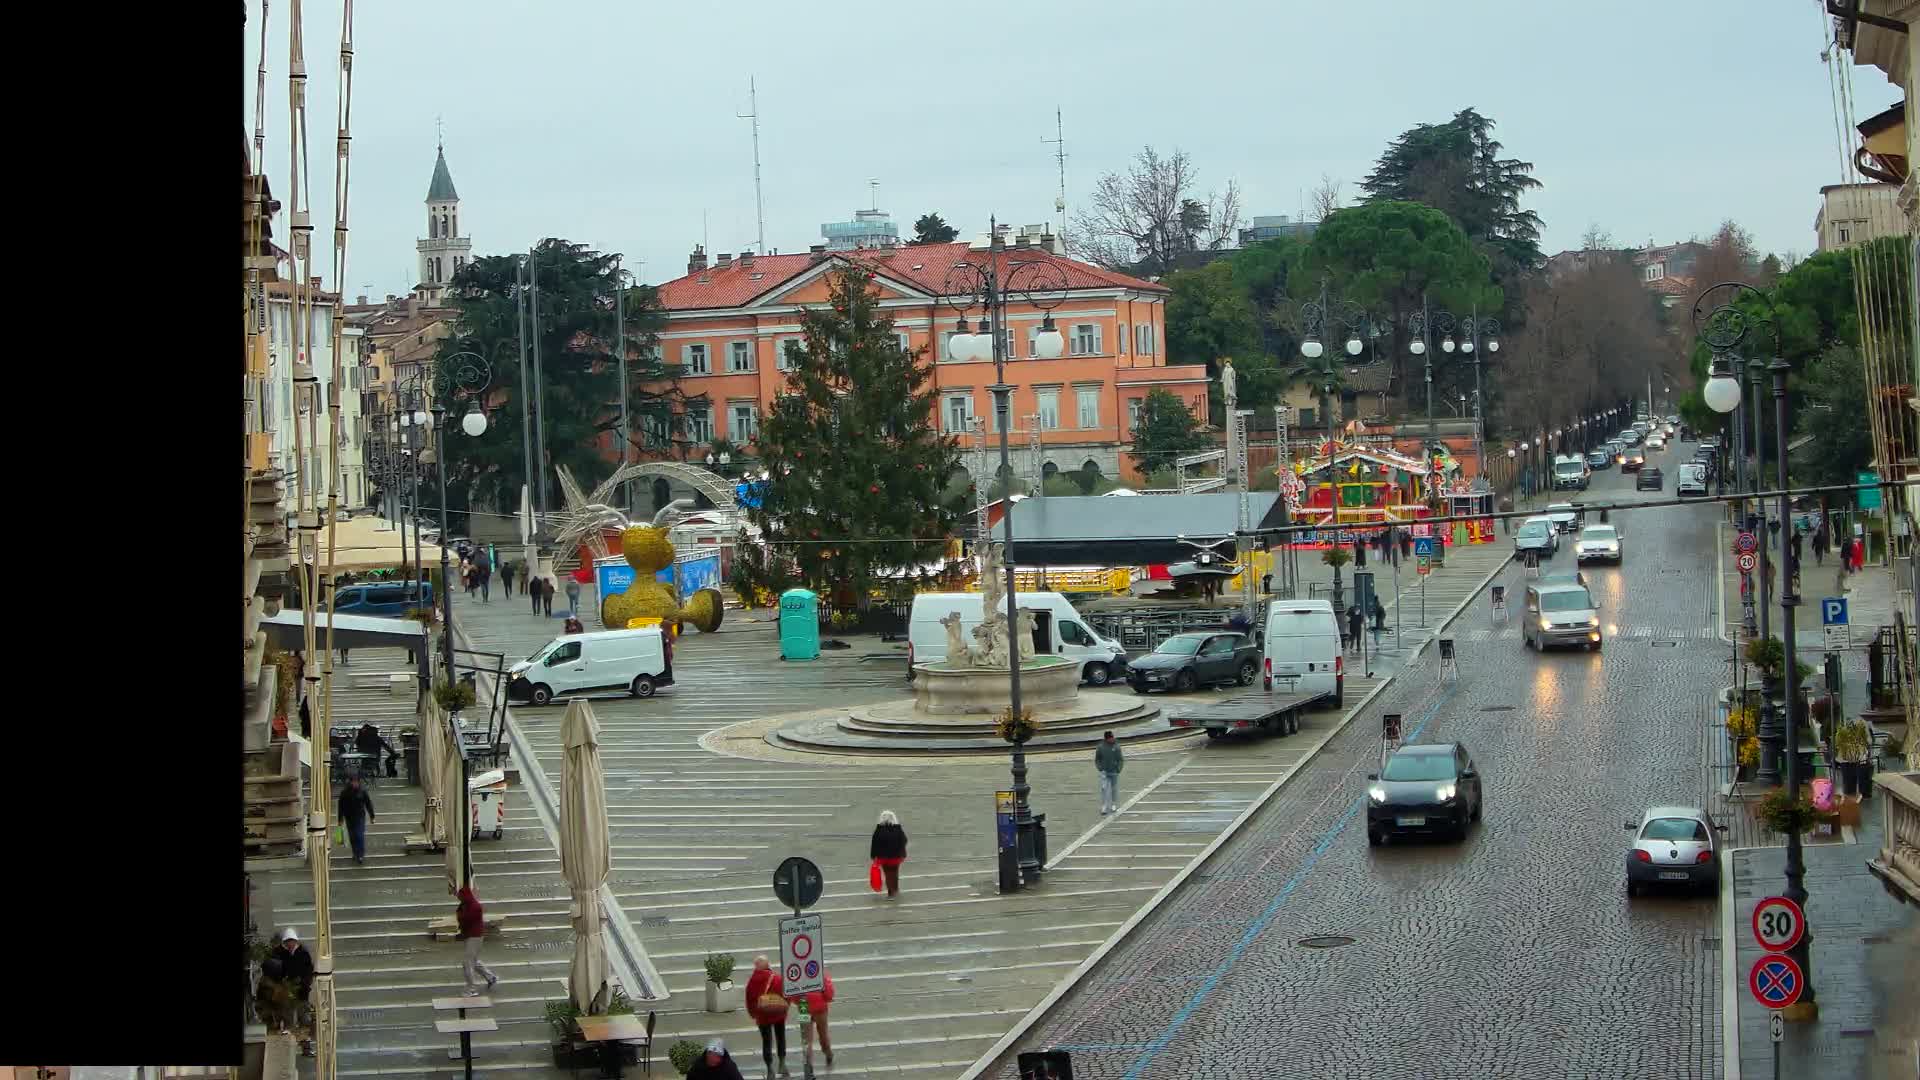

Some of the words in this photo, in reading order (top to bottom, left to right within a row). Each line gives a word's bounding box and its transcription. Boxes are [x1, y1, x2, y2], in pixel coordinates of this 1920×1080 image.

[1742, 558, 1752, 566] 20
[1826, 602, 1842, 622] P
[1762, 911, 1792, 937] 30
